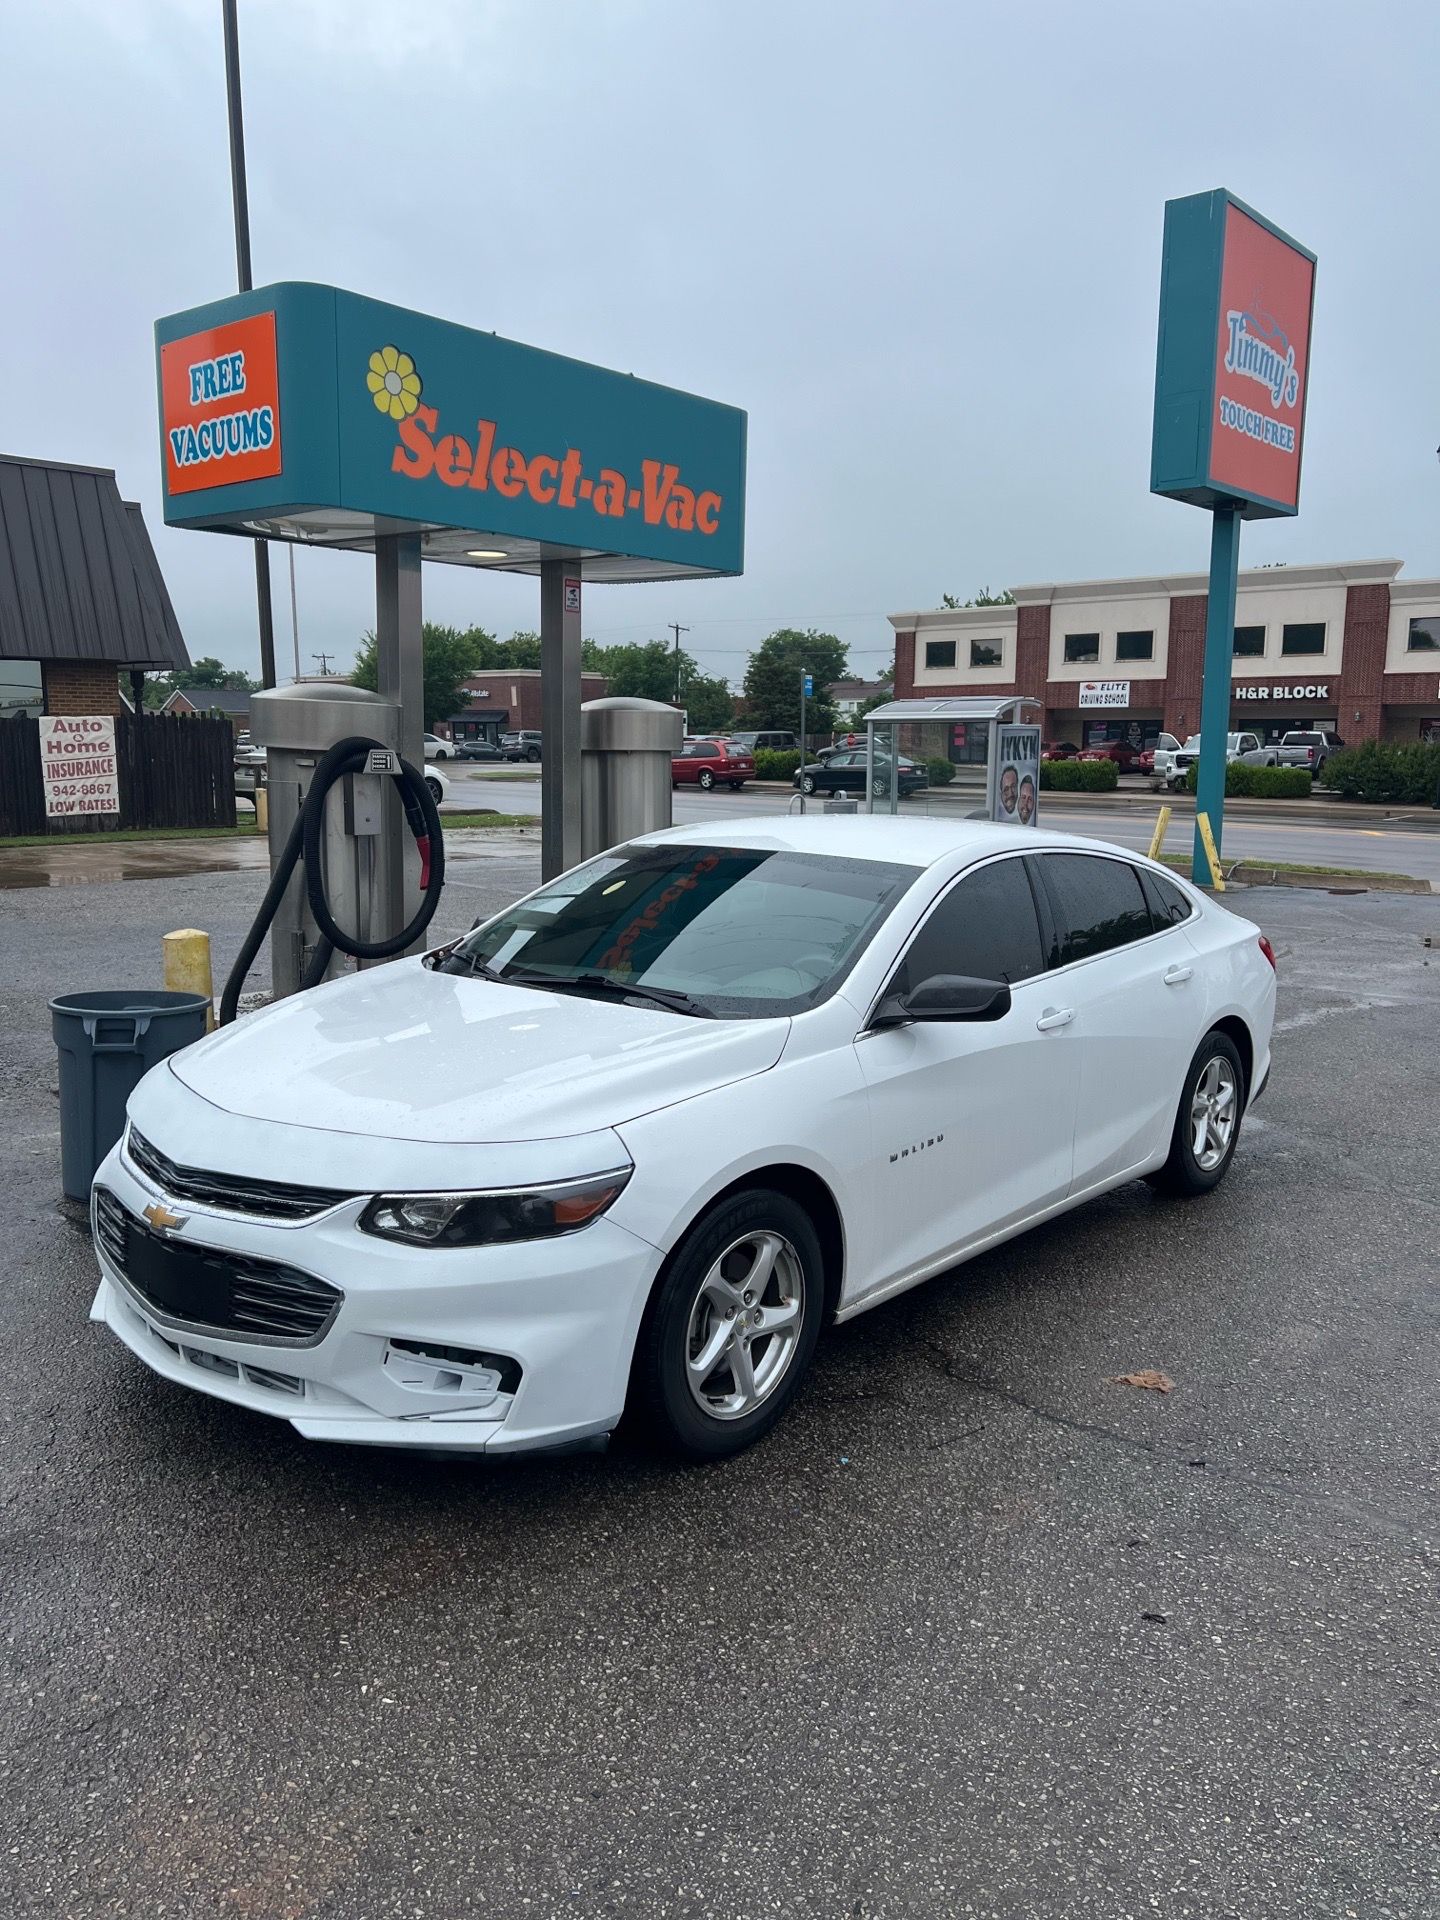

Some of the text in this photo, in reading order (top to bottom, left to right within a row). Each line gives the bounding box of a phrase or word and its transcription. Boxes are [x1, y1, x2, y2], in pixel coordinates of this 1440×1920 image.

[1226, 314, 1298, 404] Jimmy's
[190, 352, 245, 403] FREE
[1221, 398, 1294, 451] TOUCH FREE
[170, 408, 273, 466] VACUUMS
[391, 402, 722, 535] Select-a-Vac
[1101, 683, 1127, 691] ELITE
[1235, 686, 1329, 699] H&R BLOCK
[1080, 694, 1127, 704] DRIVING SCHOOL
[53, 719, 102, 733] Auto
[47, 741, 110, 754] Home
[47, 758, 114, 779] INSURANCE
[52, 783, 111, 796] 942-8867
[49, 798, 116, 813] LOW RATES!
[889, 1133, 944, 1163] MALIBU
